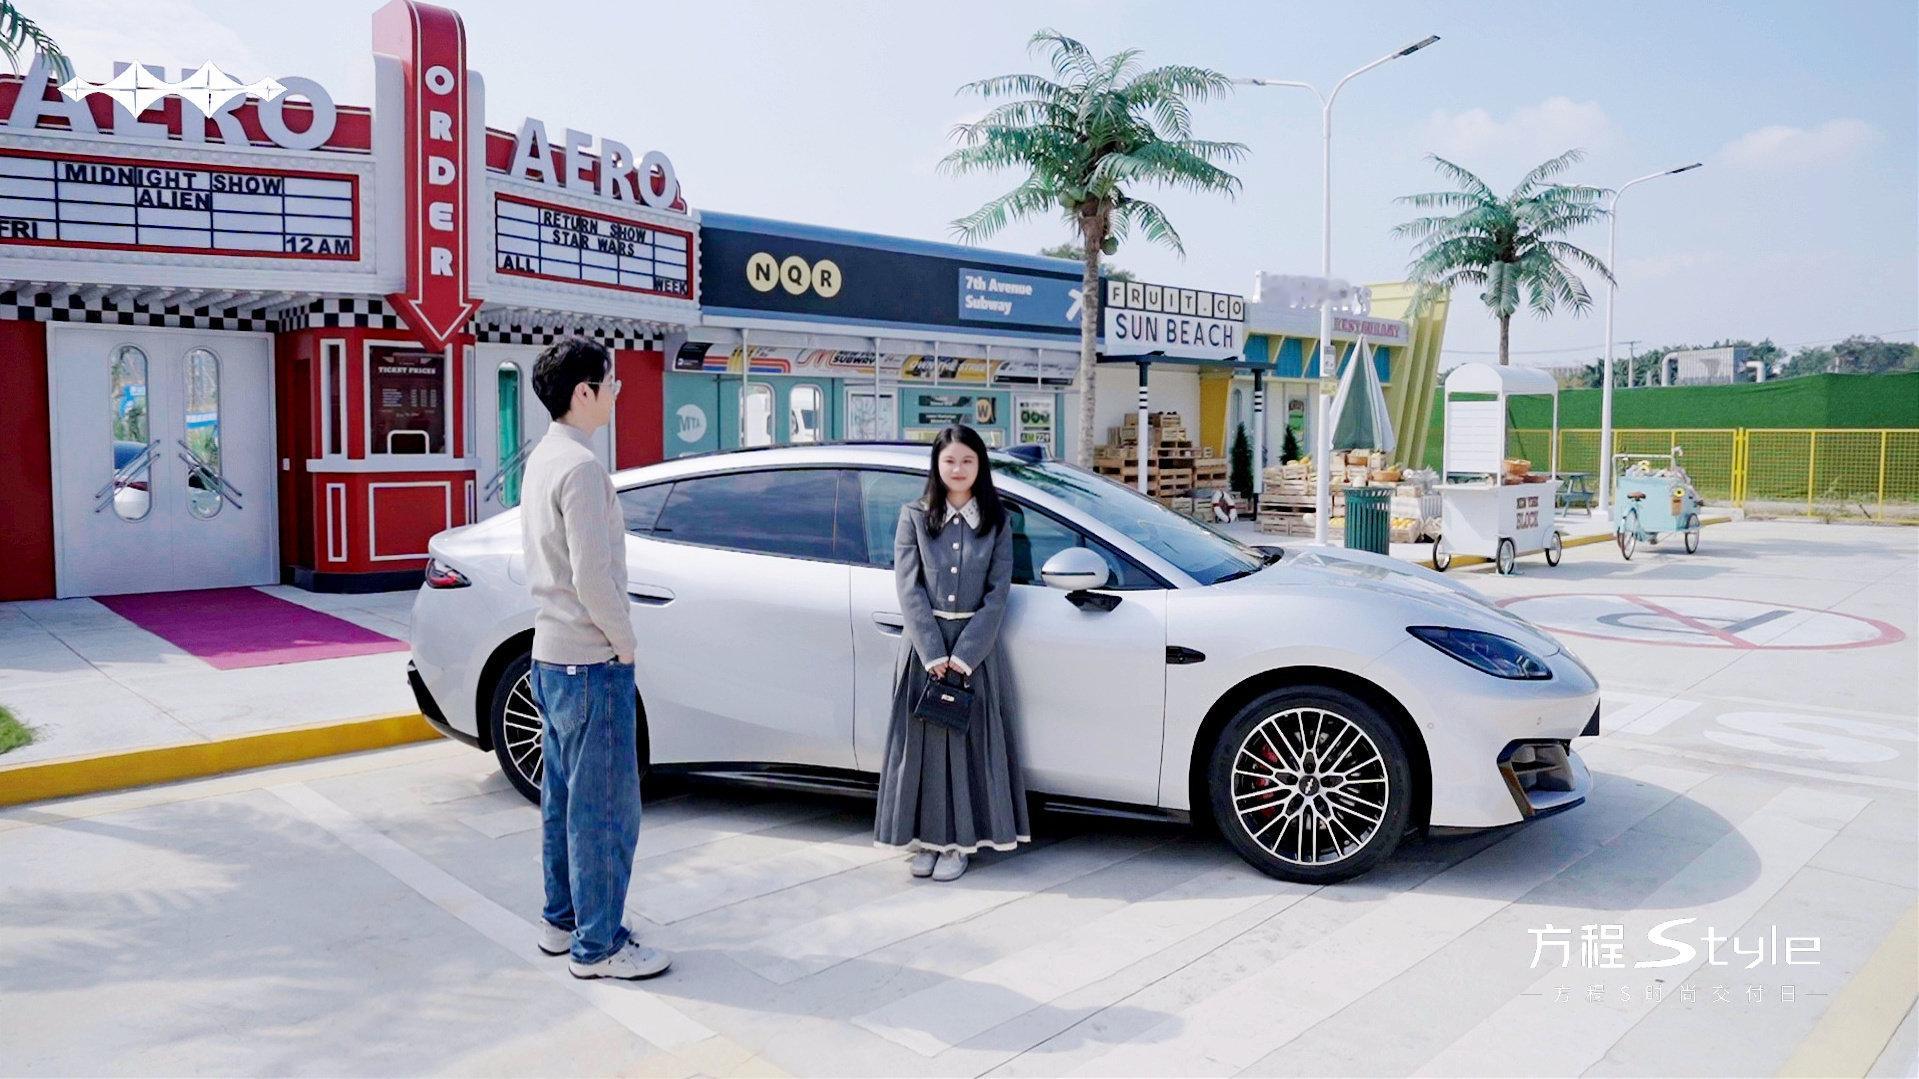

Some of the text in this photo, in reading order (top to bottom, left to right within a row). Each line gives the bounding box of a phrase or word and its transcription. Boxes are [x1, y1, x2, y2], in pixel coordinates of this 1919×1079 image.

[425, 66, 456, 277] ORDER
[511, 117, 677, 208] AERO
[65, 163, 282, 195] MIDNIGHT SHOW
[138, 188, 210, 210] ALIEN
[0, 219, 38, 239] FRI
[543, 211, 646, 244] RETURN SHOW
[553, 229, 635, 257] STAR WARS
[503, 255, 535, 273] ALL
[654, 279, 688, 294] WEEK
[964, 275, 1033, 296] 7th Avenue
[964, 295, 1013, 315] Subway
[1115, 313, 1234, 349] SUN BEACH
